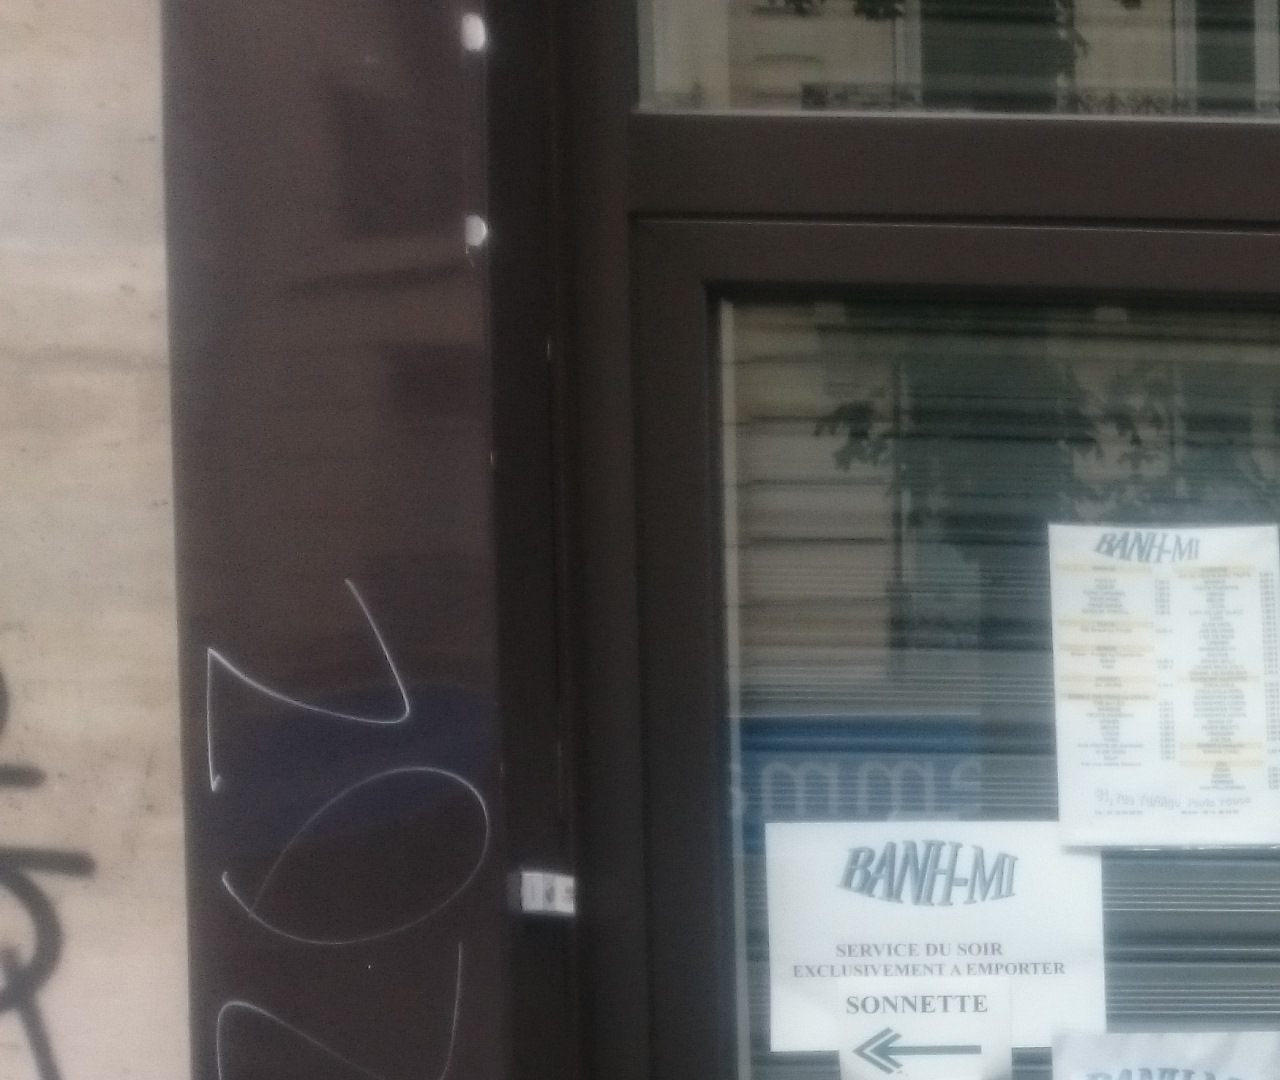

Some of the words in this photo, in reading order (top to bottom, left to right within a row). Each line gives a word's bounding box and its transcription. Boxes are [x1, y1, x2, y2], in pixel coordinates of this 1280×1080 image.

[1094, 530, 1201, 564] BANH-MI
[836, 839, 1019, 907] BANH-MI
[836, 942, 920, 959] SERVICE
[926, 942, 951, 957] DU
[957, 941, 1004, 957] SOIR
[793, 963, 946, 979] EXCLUSIVEMENT
[950, 964, 962, 977] A
[966, 961, 1066, 977] EMPORTER
[845, 993, 989, 1015] SONNETTE
